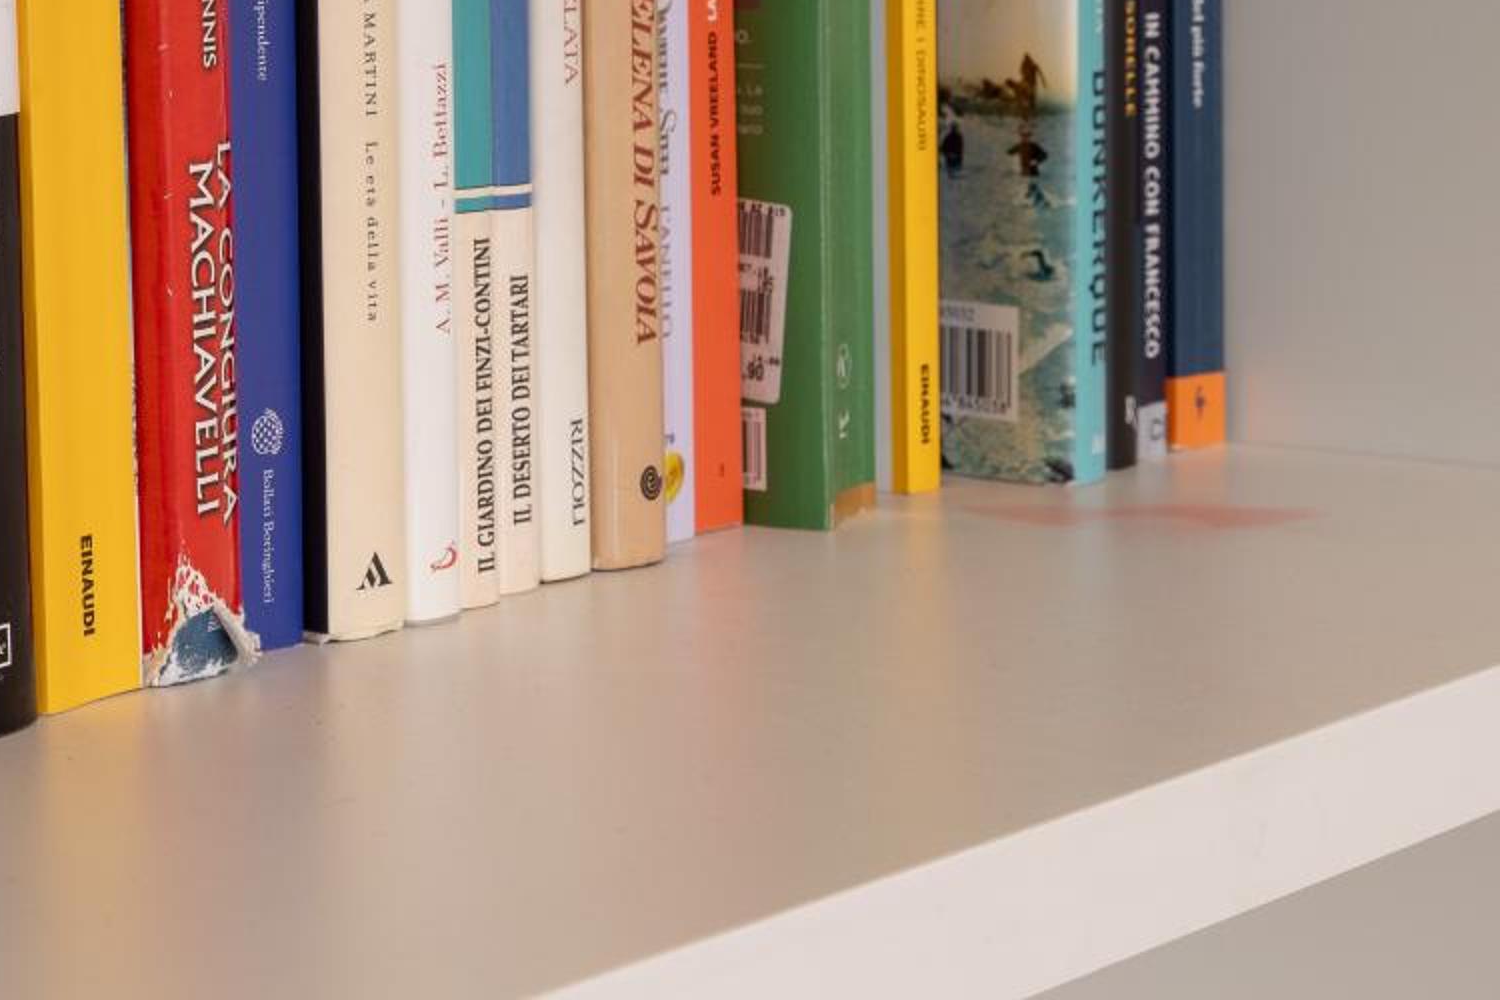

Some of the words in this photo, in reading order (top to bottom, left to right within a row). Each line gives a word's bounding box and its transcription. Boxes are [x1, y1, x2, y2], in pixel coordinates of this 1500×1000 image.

[363, 11, 379, 118] MARTINI
[1143, 11, 1161, 39] IN
[707, 31, 720, 128] VREELAND
[916, 49, 928, 152] DINOSAURI
[1143, 45, 1162, 160] CAMMINO
[1191, 60, 1206, 109] forte
[215, 141, 234, 210] LA
[633, 145, 656, 189] DI
[709, 133, 722, 196] SUSAN
[1144, 166, 1162, 217] CON
[366, 215, 380, 272] della
[1088, 70, 1106, 367] DUNKERQUE
[366, 279, 378, 323] vita
[473, 236, 494, 392] FINZI-CONTINI
[510, 274, 531, 362] TARTARI
[633, 199, 659, 345] SAVOIA
[1143, 222, 1163, 360] FRANCESCO
[188, 161, 220, 516] MACHIAVELLI
[217, 228, 241, 526] CONGIURA
[512, 365, 531, 403] DEI
[476, 395, 494, 436] DEI
[920, 363, 931, 445] EINAUDI
[477, 438, 496, 548] GIARDINO
[511, 405, 532, 503] DESERTO
[569, 418, 586, 527] RIZZOLI
[513, 505, 532, 526] IL
[79, 534, 95, 637] EINAUDI
[477, 553, 496, 574] IL
